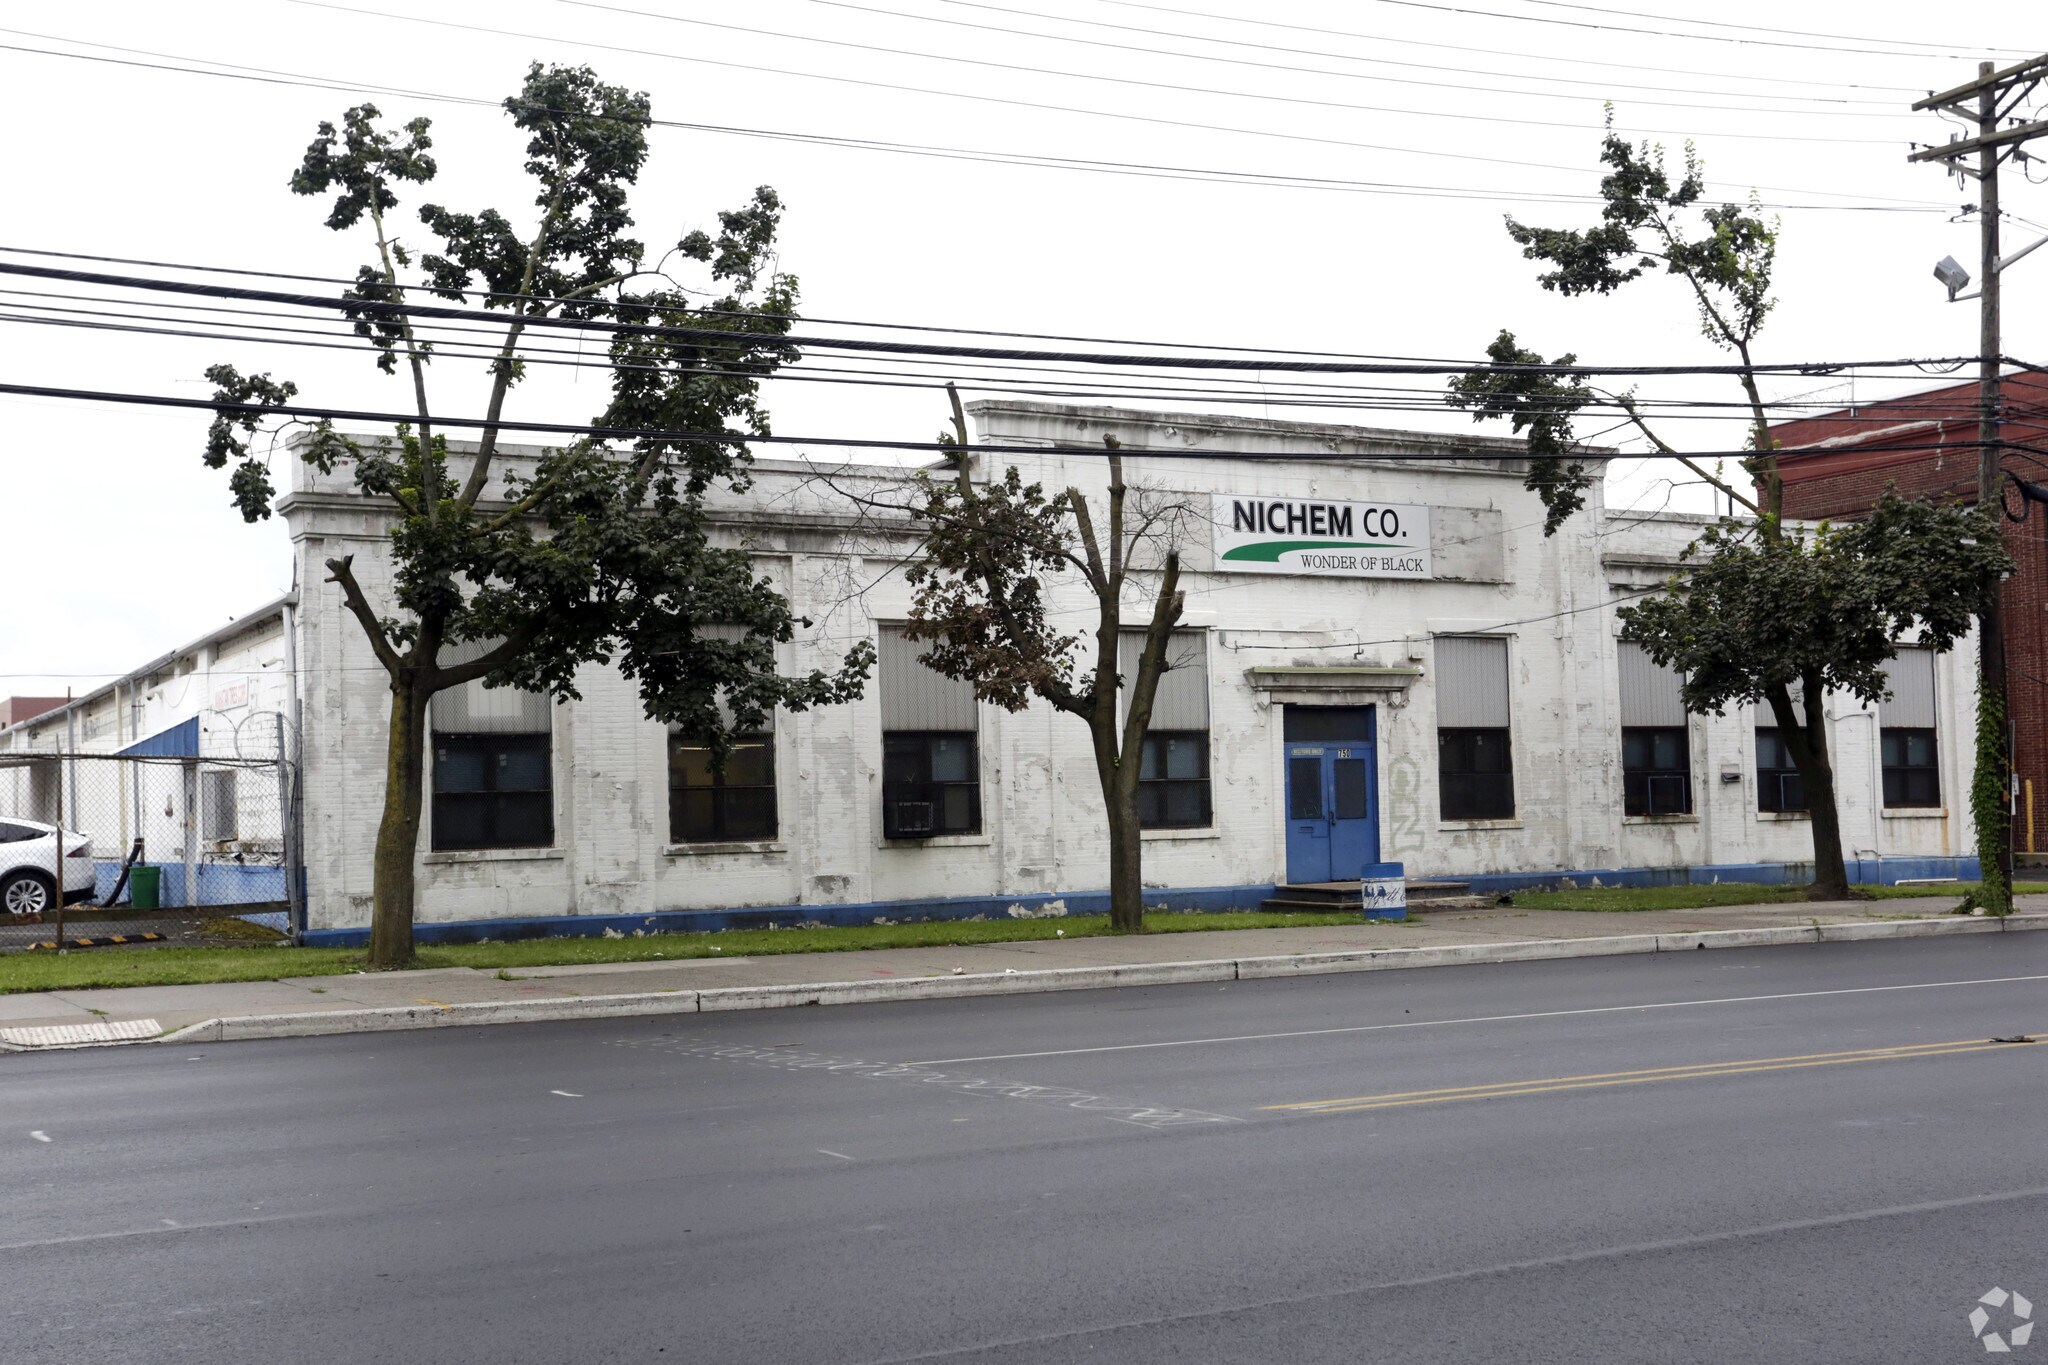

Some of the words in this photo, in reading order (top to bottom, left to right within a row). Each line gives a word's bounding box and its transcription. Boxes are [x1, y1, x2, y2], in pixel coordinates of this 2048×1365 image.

[1233, 500, 1353, 537] NICHEM
[1363, 508, 1407, 538] CO.
[1301, 555, 1357, 570] WONDER
[1360, 556, 1377, 570] OF
[1381, 558, 1423, 572] BLACK
[1338, 749, 1351, 758] 750
